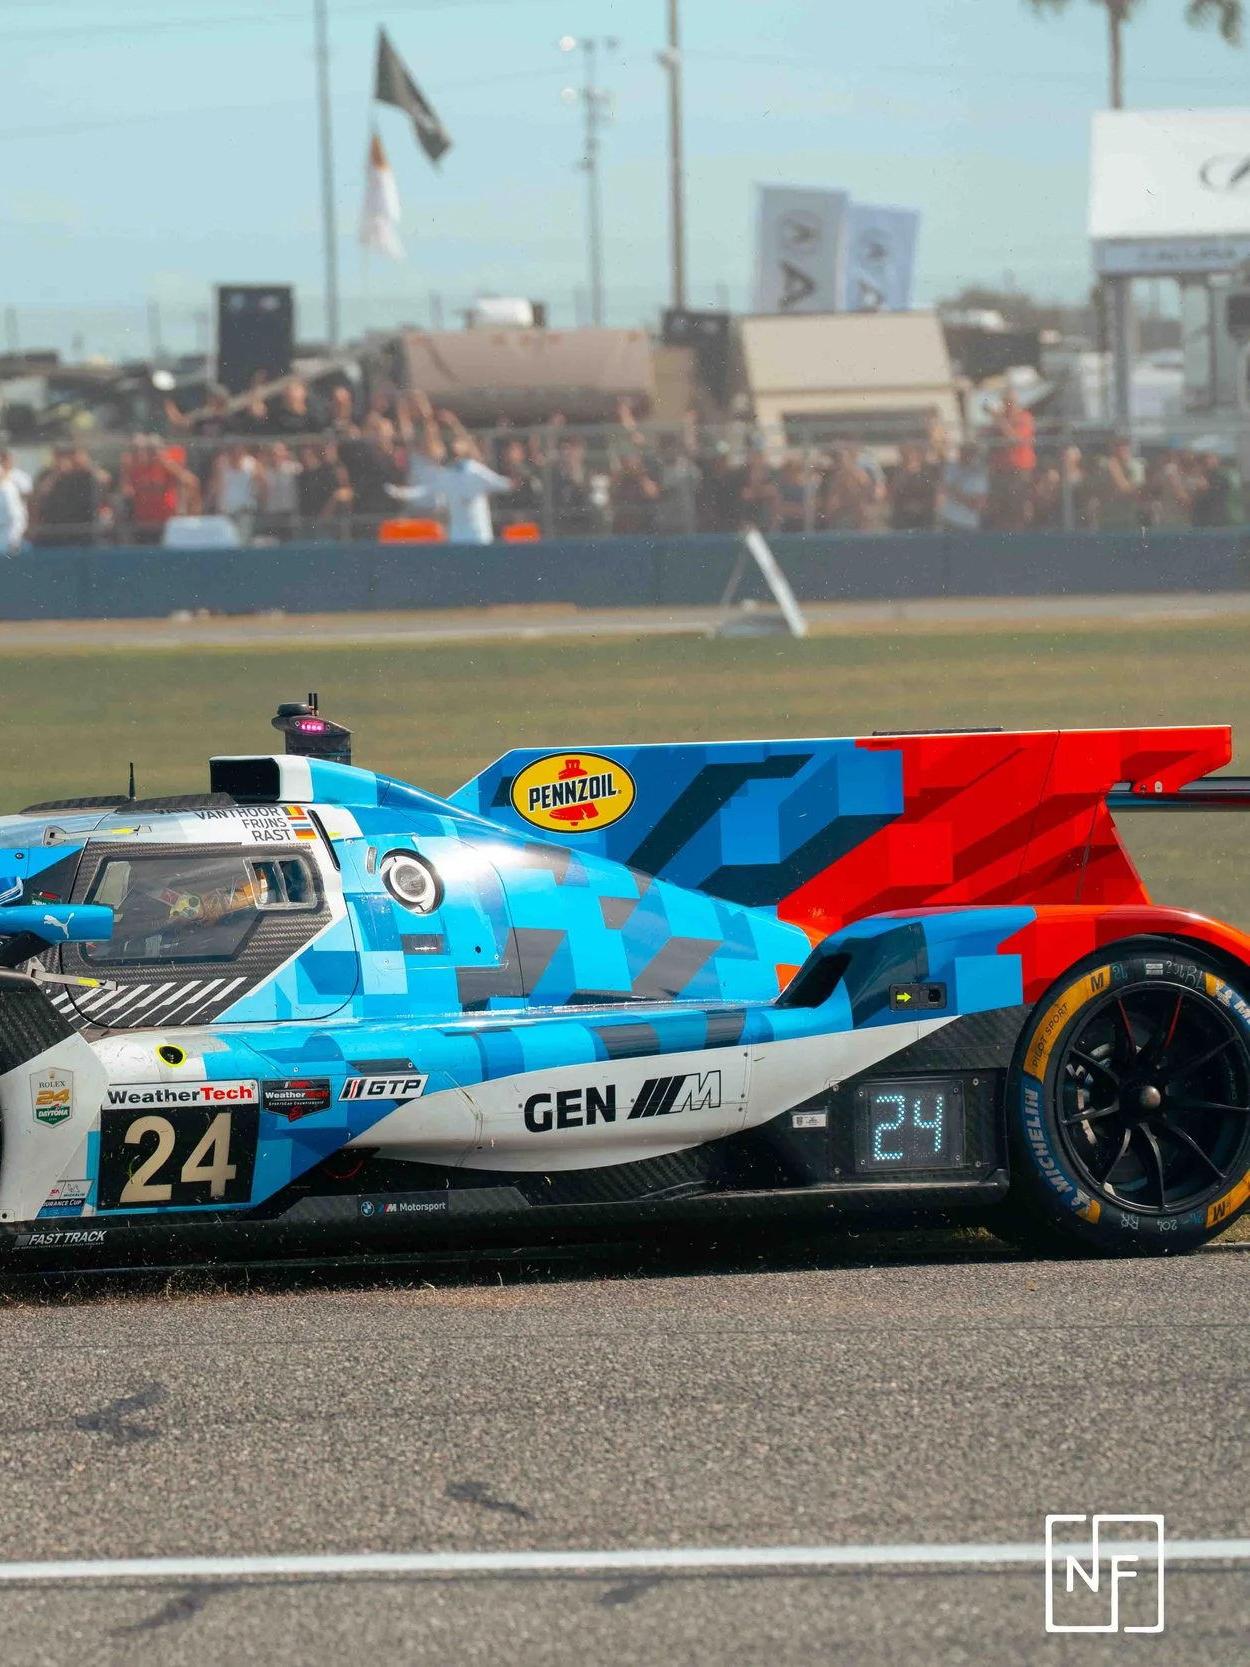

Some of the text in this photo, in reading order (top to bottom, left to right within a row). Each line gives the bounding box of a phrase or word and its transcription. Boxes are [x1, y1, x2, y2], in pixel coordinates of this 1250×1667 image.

[528, 773, 617, 811] PENNZOIL
[194, 806, 281, 820] VANTHOOR
[242, 817, 287, 829] FRIJNS
[251, 829, 292, 842] RAST
[1091, 971, 1105, 992] M
[1031, 1002, 1069, 1068] PILOT SPORT
[38, 1080, 66, 1089] ROLEX
[366, 1078, 423, 1096] GTP
[36, 1088, 70, 1105] 24
[107, 1085, 253, 1104] WeatherTech
[265, 1090, 329, 1099] WeatherTech
[38, 1109, 69, 1117] DAYTONA
[523, 1083, 616, 1133] GEN
[874, 1094, 943, 1160] 24
[1024, 1087, 1074, 1193] MICHELIN
[119, 1112, 237, 1203] 24
[399, 1202, 446, 1212] Motorsport
[1212, 1205, 1226, 1221] M
[28, 1230, 108, 1246] FAST TRACK
